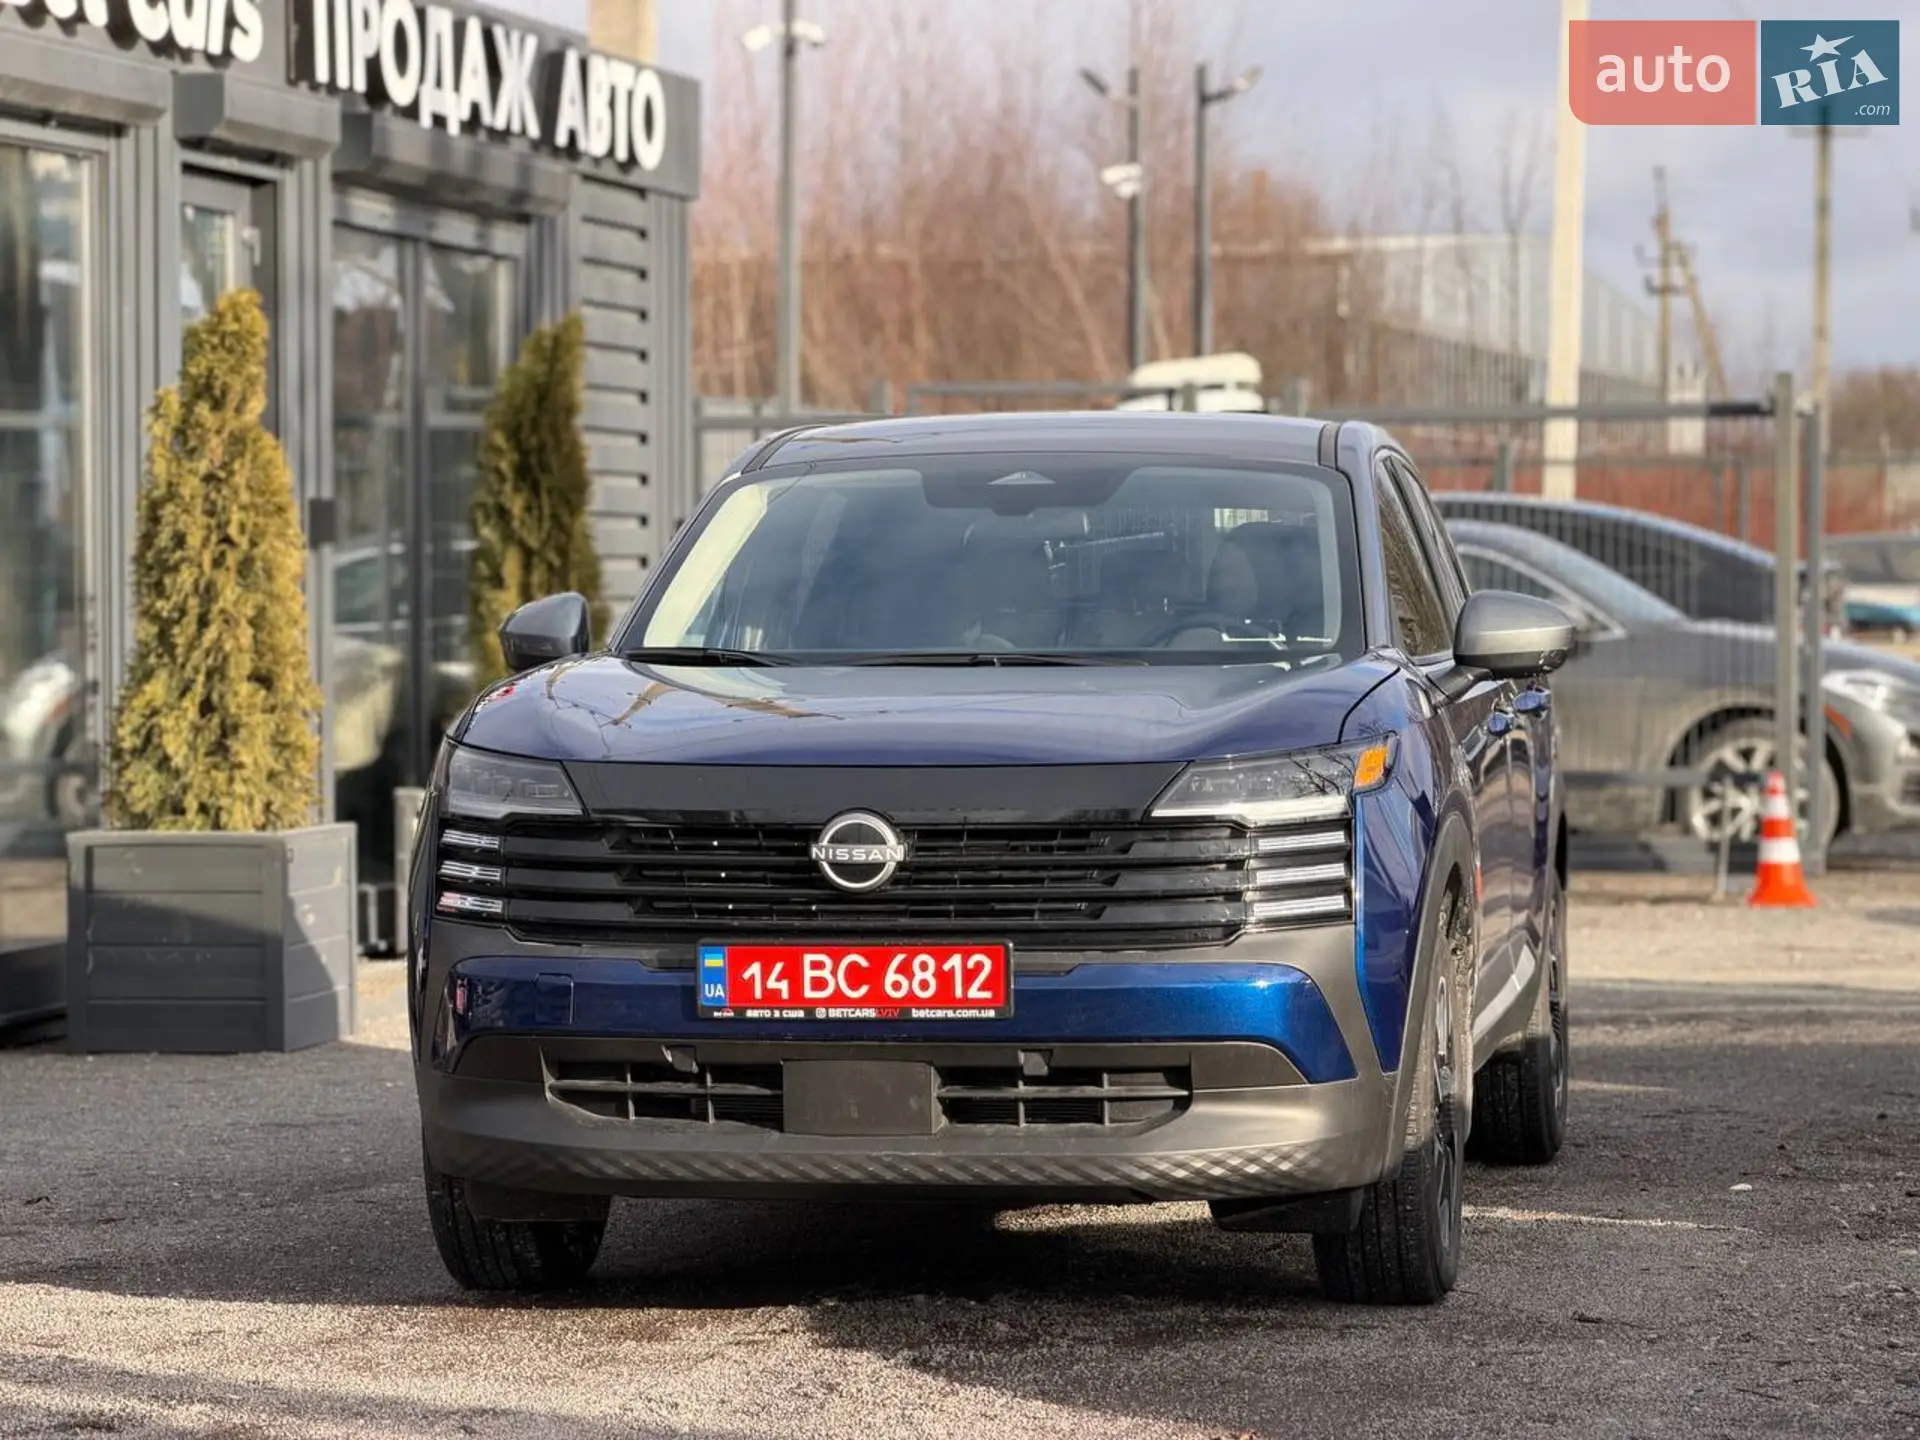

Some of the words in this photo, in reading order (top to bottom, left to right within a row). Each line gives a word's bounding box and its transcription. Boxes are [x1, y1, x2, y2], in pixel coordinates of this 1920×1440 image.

[313, 0, 541, 137] ПРОДАЖ
[554, 46, 666, 171] АВТО
[811, 847, 902, 861] NISSAN
[742, 961, 790, 1000] 14
[803, 953, 871, 999] BC
[884, 953, 993, 999] 6812
[704, 983, 725, 998] UA
[911, 1008, 996, 1018] betcars.com.ua
